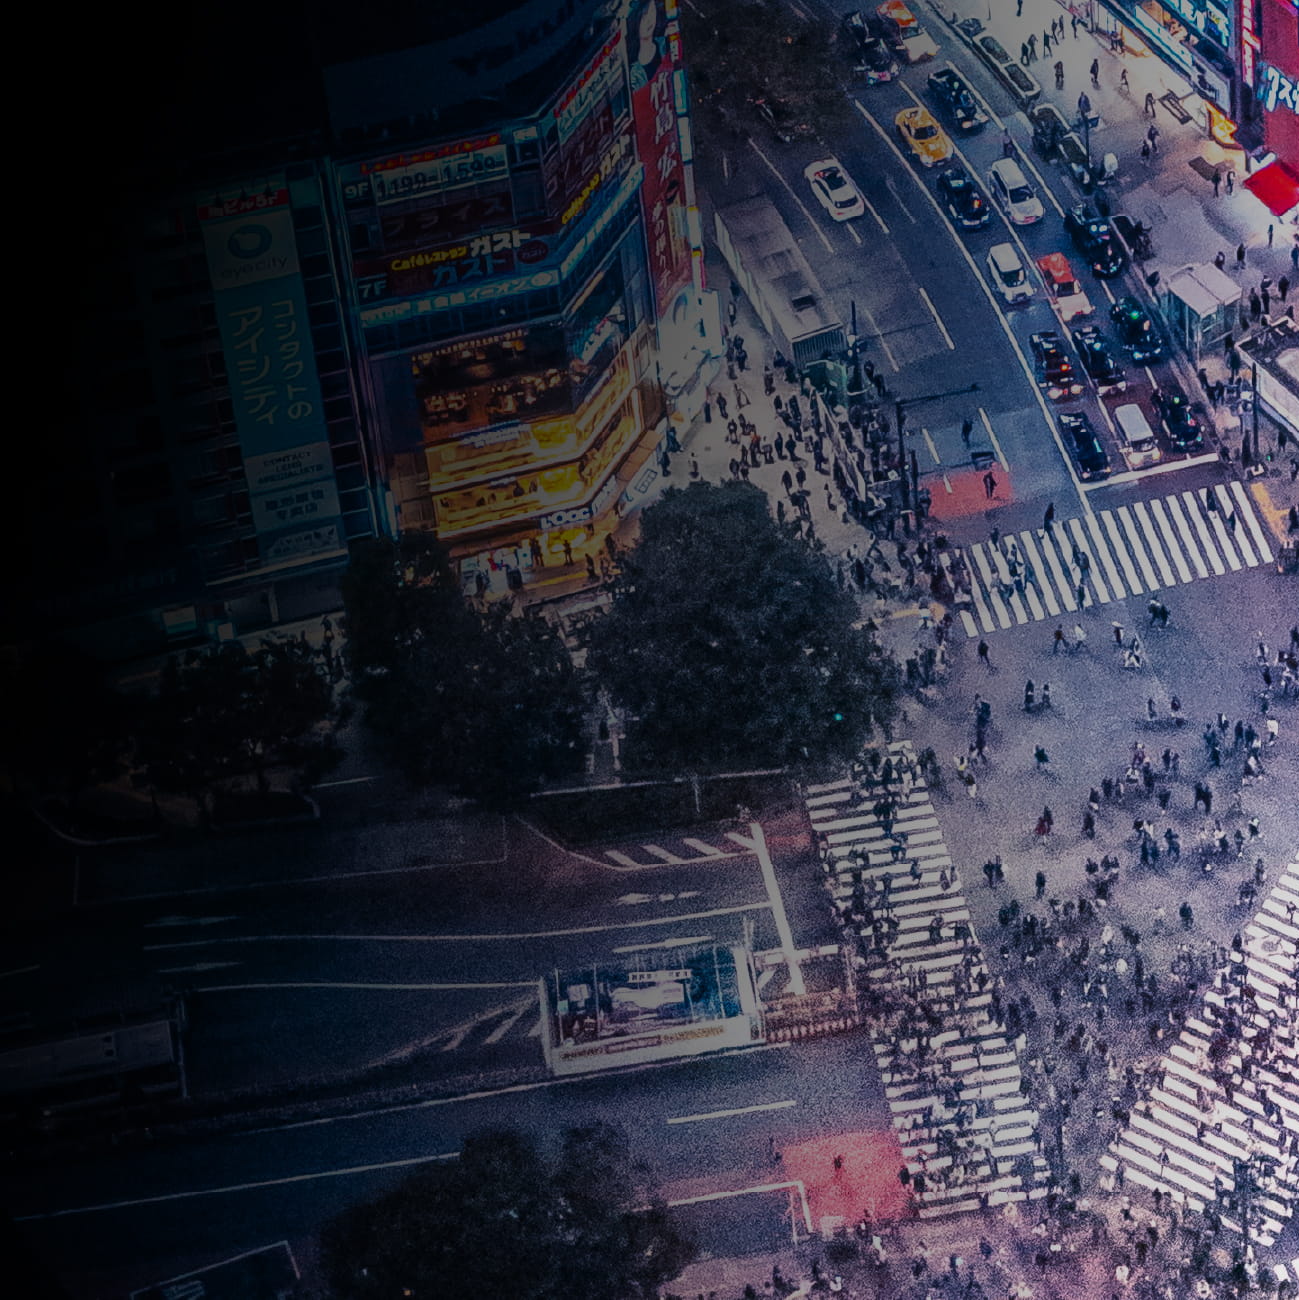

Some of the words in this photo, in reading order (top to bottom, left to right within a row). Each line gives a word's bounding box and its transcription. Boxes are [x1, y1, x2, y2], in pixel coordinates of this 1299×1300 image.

[344, 182, 368, 199] 9F
[469, 229, 532, 258] ガスト
[431, 253, 507, 288] ガスト
[359, 279, 388, 299] 7F
[226, 304, 278, 425] アイシティ
[271, 299, 313, 421] コンタクトの
